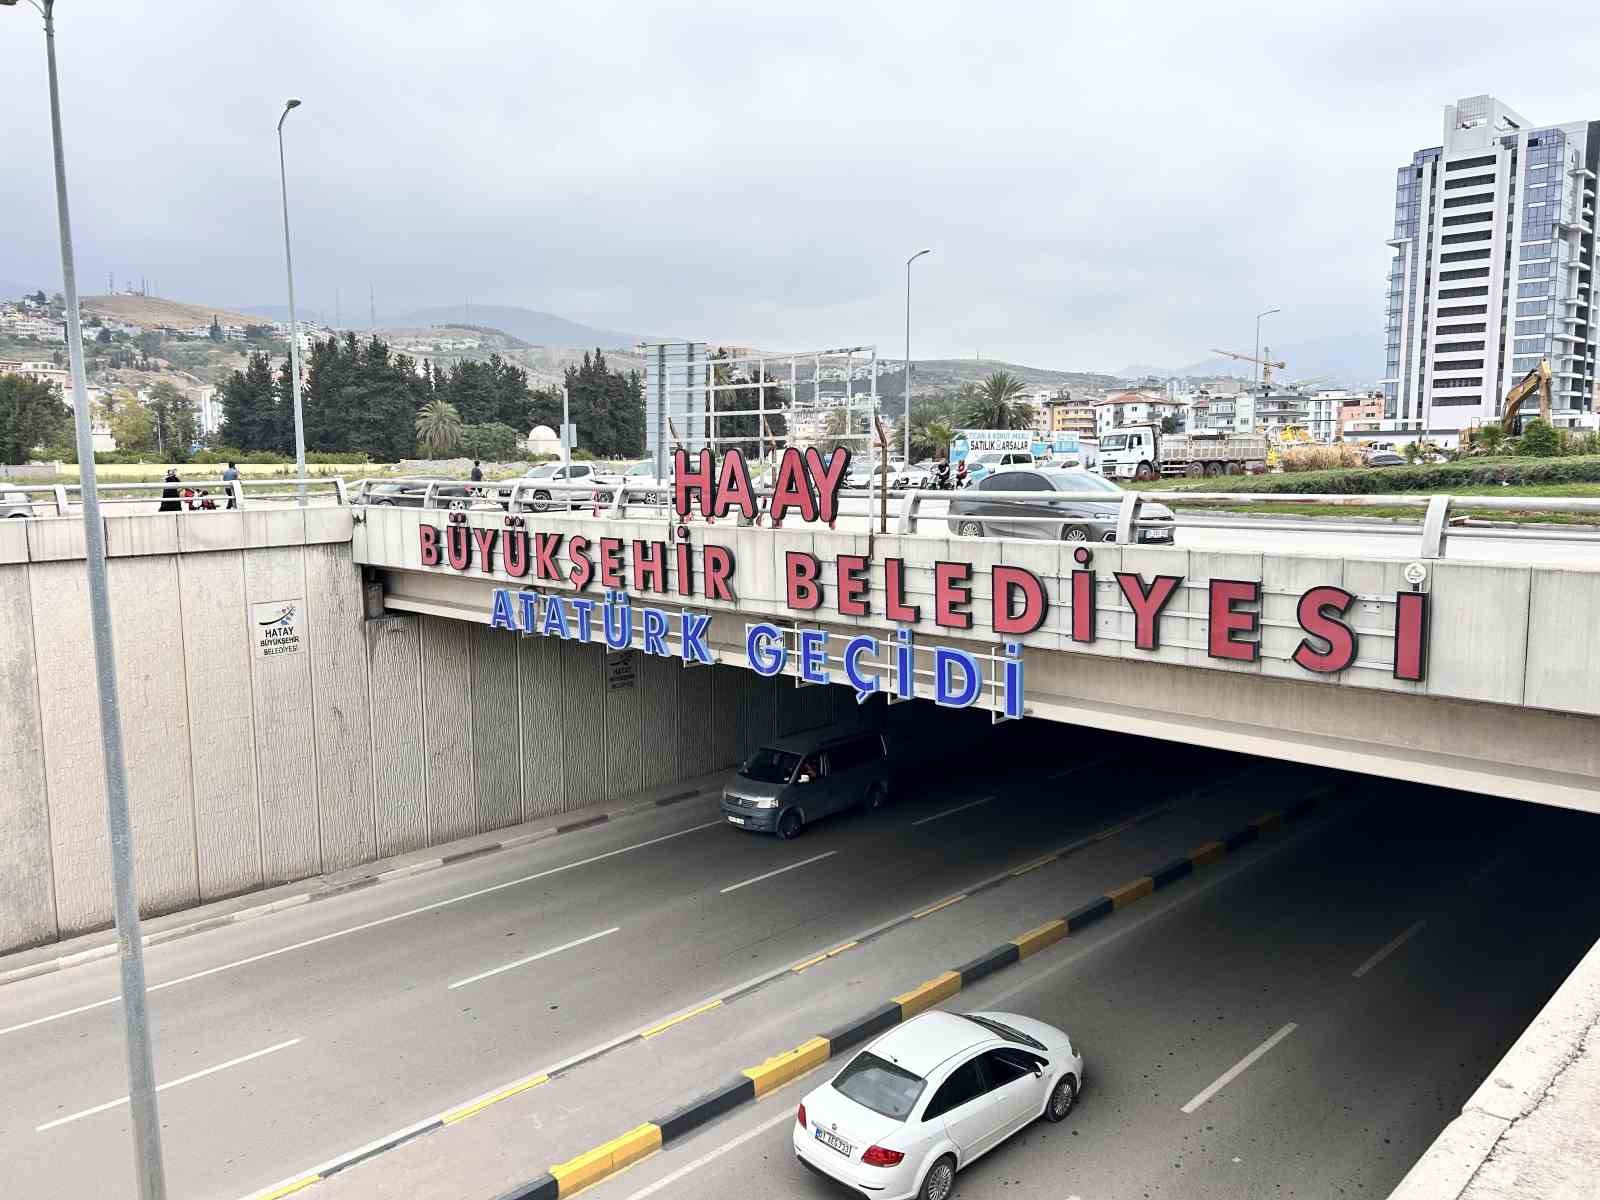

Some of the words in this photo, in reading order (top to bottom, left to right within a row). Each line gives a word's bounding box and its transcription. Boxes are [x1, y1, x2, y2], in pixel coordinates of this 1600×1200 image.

[970, 440, 995, 451] SATILIK
[1002, 440, 1028, 451] ARSALAR
[419, 512, 736, 602] BÜYÜKŞEHİR
[265, 626, 293, 638] HATAY
[490, 588, 715, 665] ATATÜRK
[746, 622, 1025, 720] GEÇİDİ
